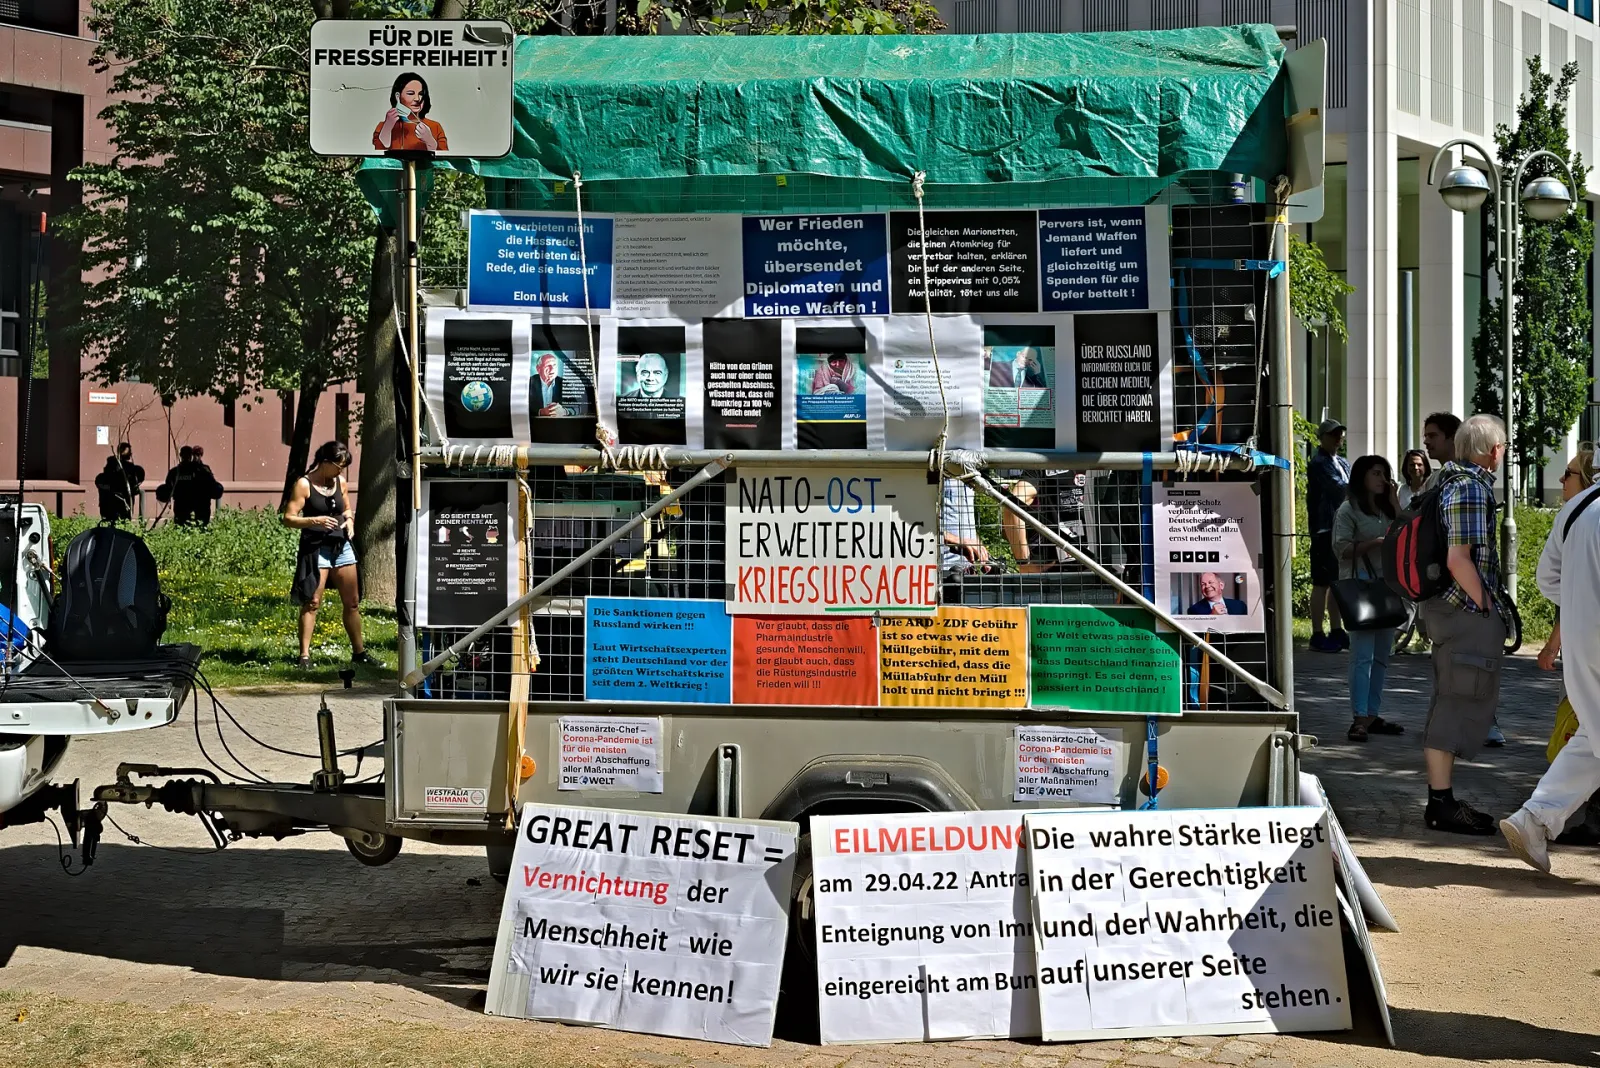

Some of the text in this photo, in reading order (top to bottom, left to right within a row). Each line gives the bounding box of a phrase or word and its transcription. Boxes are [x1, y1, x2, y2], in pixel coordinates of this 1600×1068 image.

[369, 25, 452, 46] FÜR DIE
[314, 49, 497, 67] FRESSEFREIHEIT
[760, 217, 864, 231] Wer Frieden
[1040, 220, 1084, 228] Pervers
[1088, 219, 1106, 228] ist,
[925, 228, 959, 237] gleichen
[963, 228, 1018, 236] Marionetten,
[1045, 232, 1137, 242] Jemand Waffen
[506, 235, 578, 247] die Hassrede.
[778, 239, 848, 253] möchte,
[950, 241, 993, 249] Atomkrieg
[487, 263, 516, 274] Rede,
[519, 264, 535, 273] die
[538, 265, 553, 273] sie
[765, 259, 862, 273] übersendet
[1047, 261, 1116, 273] gleichzeitig
[746, 280, 882, 297] Diplomaten und
[1052, 289, 1135, 300] Opfer bettelt !
[514, 291, 568, 302] Elon Musk
[753, 301, 876, 315] keine Waffen !
[1081, 343, 1151, 359] ÜBER RUSSLAND
[710, 362, 725, 370] Hätte
[739, 362, 750, 370] den
[751, 362, 773, 370] Grünen
[1082, 362, 1152, 372] INFORMIEREN EUCH DIE
[1082, 377, 1152, 390] GLEICHEN MEDIEN,
[1083, 393, 1153, 406] DIE ÜBER CORONA
[722, 408, 761, 416] tödlich endet
[1083, 411, 1153, 423] BERICHTET HABEN.
[739, 522, 934, 558] ERWEITERUNG:
[739, 565, 937, 605] KRIEGSURSACHE
[593, 608, 705, 620] Die Sanktionen gegen
[1068, 619, 1115, 628] irgendwo
[756, 634, 833, 642] Pharmaindustrie
[882, 632, 897, 640] ist
[917, 633, 952, 641] etwas
[956, 634, 978, 642] wie
[981, 634, 999, 642] die
[756, 646, 794, 654] gesunde
[848, 646, 865, 654] will,
[883, 645, 1009, 657] Müllgebühr, mit dem
[622, 656, 686, 665] Deutschland
[710, 658, 728, 666] der
[756, 680, 791, 688] Frieden
[794, 680, 809, 688] will
[1037, 685, 1079, 693] passiert
[1095, 685, 1159, 693] Deutschland
[563, 735, 639, 744] Corona-Pandemie
[1020, 745, 1112, 755] Corona-Pandemie ist
[584, 766, 639, 774] Maßnahmen!
[526, 815, 638, 853] GREAT
[650, 825, 754, 863] RESET
[1032, 822, 1324, 850] Die wahre Stärke liegt
[820, 871, 1029, 892] am 29.04.22 Antra
[1040, 861, 1307, 892] in der Gerechtigkeit
[523, 866, 728, 904] Vernichtung der
[1044, 904, 1333, 938] und der Wahrheit, die
[523, 917, 733, 956] Menschheit wie
[822, 922, 944, 946] Enteignung
[951, 923, 990, 939] von
[1041, 954, 1266, 985] auf unserer Seite
[540, 964, 734, 1003] wir sie kennen!
[825, 972, 1036, 999] eingereicht am Bun
